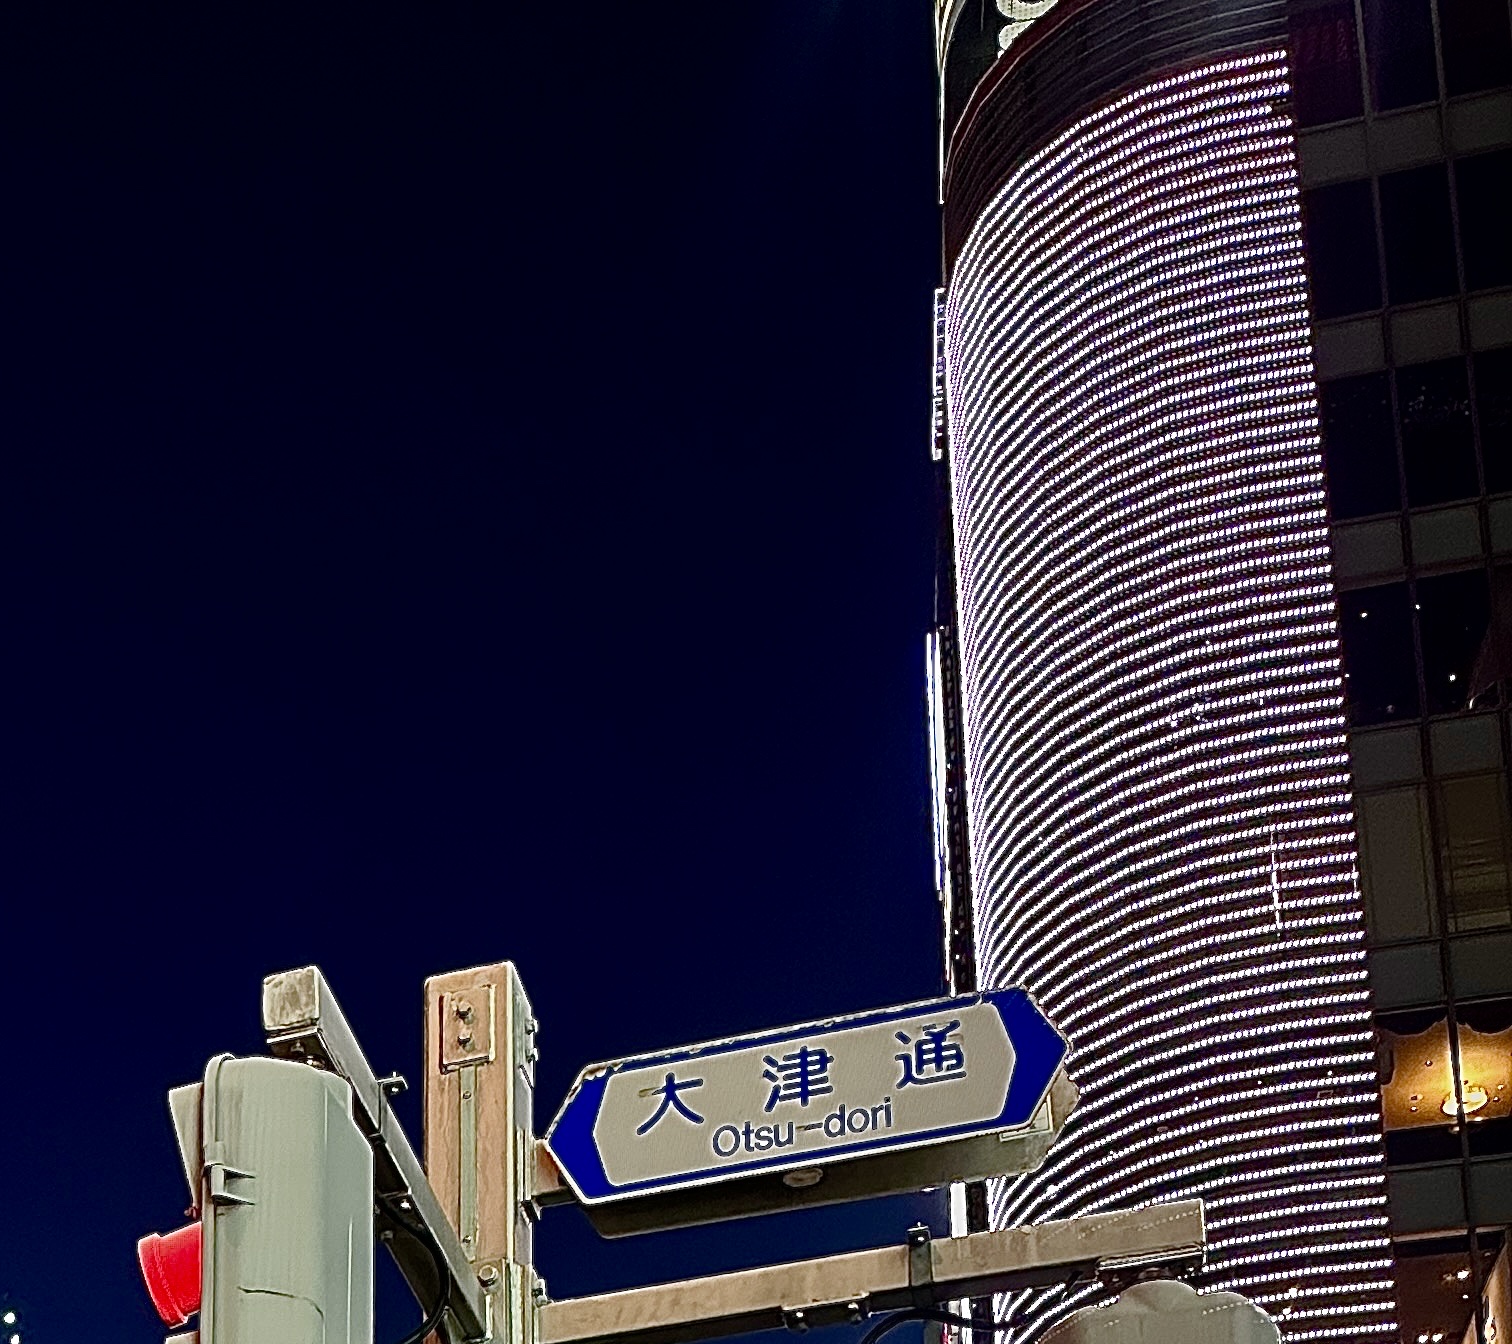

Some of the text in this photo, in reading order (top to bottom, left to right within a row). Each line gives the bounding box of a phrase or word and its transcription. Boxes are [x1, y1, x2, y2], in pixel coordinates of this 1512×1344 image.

[635, 1018, 968, 1137] 大津通
[710, 1096, 893, 1159] Otsu-dori
